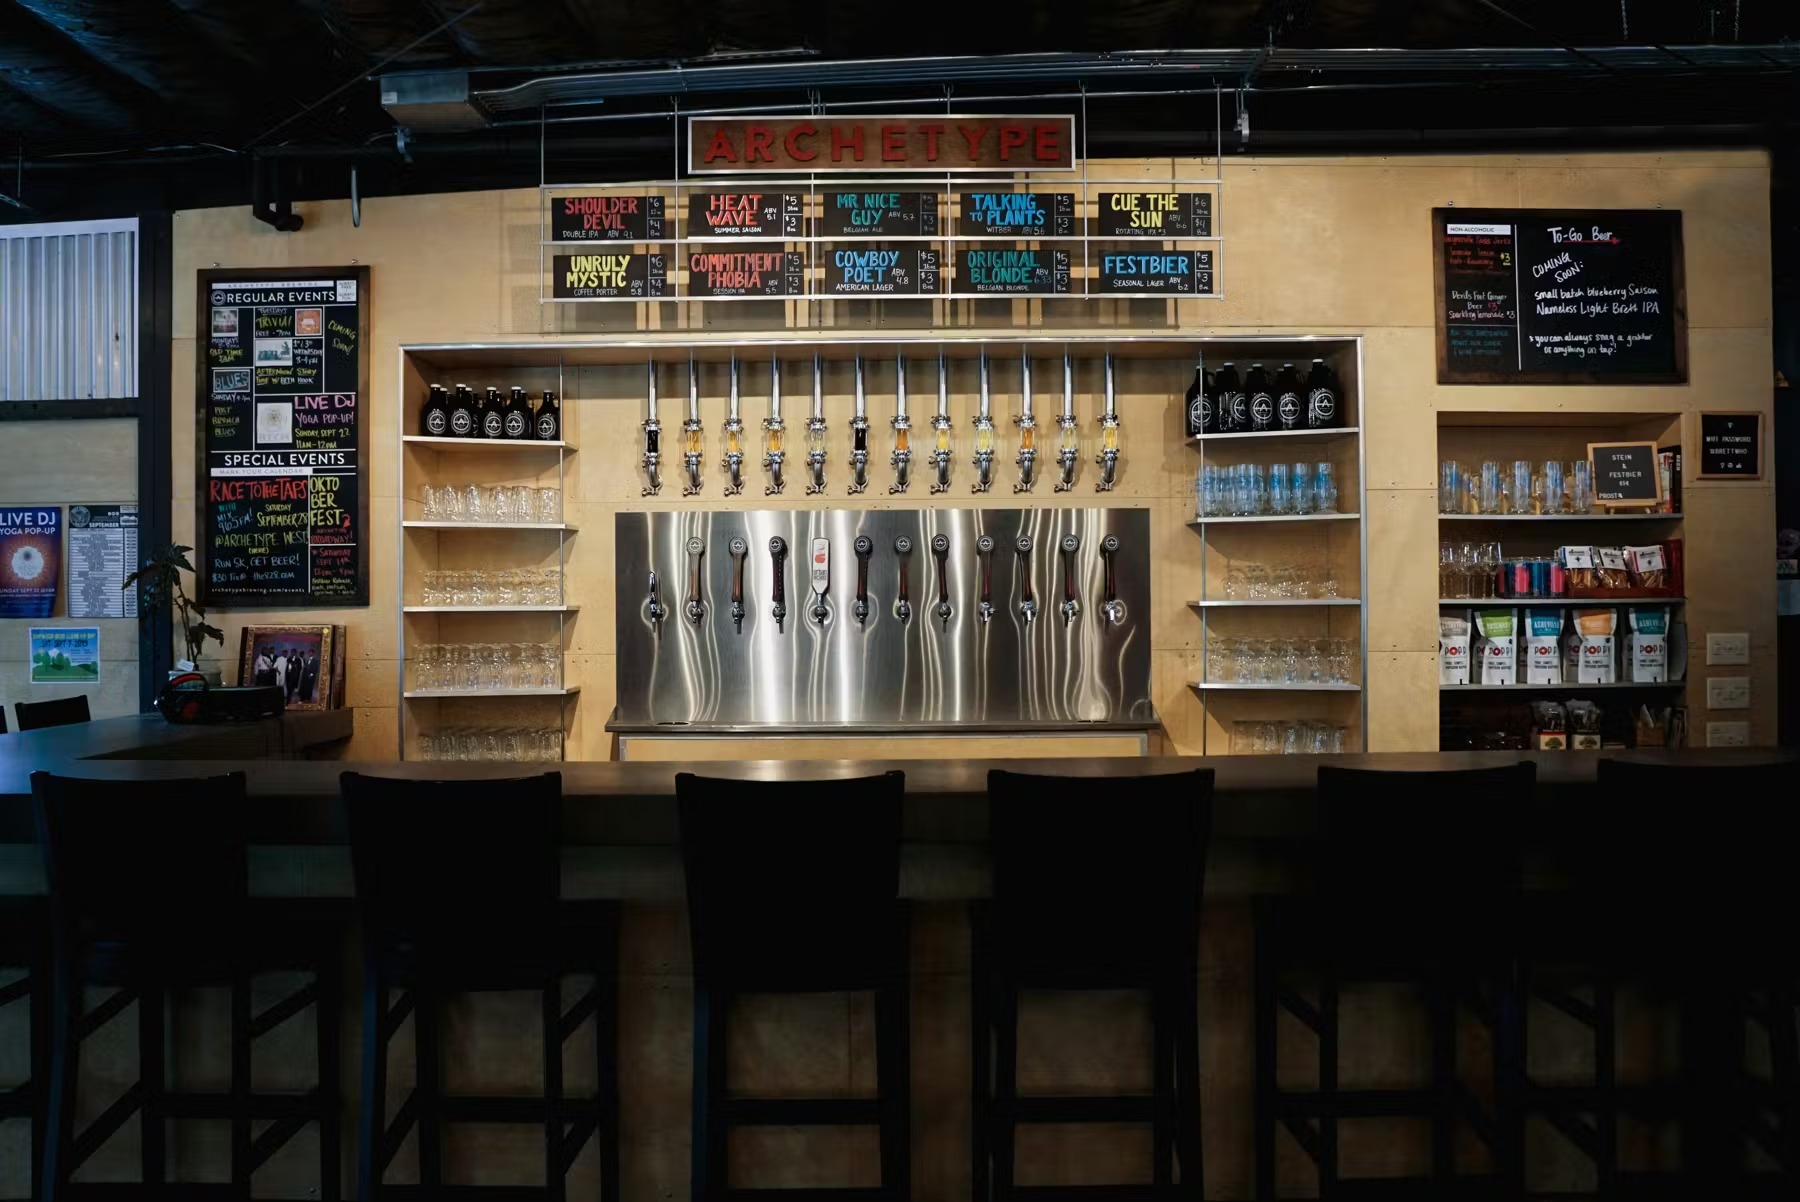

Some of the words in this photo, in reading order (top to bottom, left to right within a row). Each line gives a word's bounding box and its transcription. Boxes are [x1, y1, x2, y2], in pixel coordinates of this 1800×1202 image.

[704, 125, 1061, 162] ARCHETYPE
[565, 198, 637, 214] SHOULDER
[649, 198, 659, 207] $6
[711, 195, 762, 210] HEAT
[786, 195, 796, 205] $5
[837, 194, 858, 208] MR
[865, 194, 900, 208] NICE
[972, 194, 1036, 210] TALKING
[1057, 195, 1069, 204] $5
[1111, 194, 1140, 210] CUE
[1146, 194, 1179, 210] THE
[1195, 197, 1206, 207] $6
[584, 215, 625, 229] DEVIL
[650, 220, 659, 229] $4
[706, 211, 757, 225] WAVE
[786, 216, 796, 226] $3
[852, 210, 882, 225] GUY
[970, 212, 982, 221] TO
[987, 210, 1046, 225] PLANTS
[1058, 218, 1068, 227] $3
[1130, 211, 1162, 227] SUN
[1195, 218, 1205, 228] $4
[1547, 227, 1582, 243] To-Go
[1592, 226, 1612, 241] Beer
[571, 255, 630, 271] UNRULY
[652, 256, 662, 267] $6
[691, 253, 784, 272] COMMITMENT
[836, 251, 899, 267] COWBOY
[921, 252, 934, 263] $5
[968, 251, 1040, 267] ORIGINAL
[1057, 252, 1067, 264] $5
[1197, 252, 1208, 262] $5
[1533, 252, 1572, 277] COMING
[892, 268, 905, 276] ABV
[1105, 256, 1188, 274] FESTBIER
[1555, 261, 1583, 282] SOON:
[567, 272, 626, 287] MYSTIC
[708, 272, 761, 288] PHOBIA
[844, 267, 886, 283] POET
[921, 272, 933, 283] $3
[971, 267, 1032, 283] BLONDE
[1057, 273, 1067, 284] $3
[1197, 272, 1208, 282] $3
[1113, 279, 1144, 287] SEASONAL
[227, 293, 283, 303] REGULAR
[289, 291, 335, 301] EVENTS
[1534, 288, 1558, 300] small
[1560, 289, 1584, 299] batch
[1587, 288, 1626, 300] blueberry
[1628, 284, 1658, 295] Saison
[1449, 311, 1476, 320] Sparkling
[1537, 304, 1576, 315] Nameless
[1581, 302, 1609, 317] Light
[1613, 302, 1638, 313] Brett
[1643, 302, 1659, 313] IPA
[328, 320, 356, 339] COMING
[1535, 336, 1549, 346] you
[1564, 332, 1592, 344] always
[1596, 334, 1613, 345] snag
[1553, 346, 1584, 357] anything
[1600, 345, 1616, 355] tap!
[297, 368, 317, 376] STORY
[215, 372, 248, 390] BLUES
[295, 396, 328, 409] LIVE
[335, 394, 355, 407] DJ
[296, 413, 318, 427] YOGA
[323, 412, 354, 424] POP-UP!
[339, 428, 350, 436] 22
[225, 455, 284, 466] SPECIAL
[290, 453, 344, 465] EVENTS
[211, 480, 244, 502] RACE
[245, 482, 262, 500] TO
[262, 481, 279, 498] THE
[276, 478, 307, 501] TAPS
[311, 477, 339, 492] OKTO
[265, 504, 292, 512] SATURDAY
[311, 493, 337, 508] BER
[0, 513, 33, 525] LIVE
[38, 512, 55, 525] DJ
[217, 512, 232, 521] MIX
[257, 512, 297, 527] SEPTEMBER
[311, 509, 344, 525] FEST
[215, 559, 232, 568] RUN
[250, 557, 267, 566] GET
[272, 553, 299, 566] BEER!
